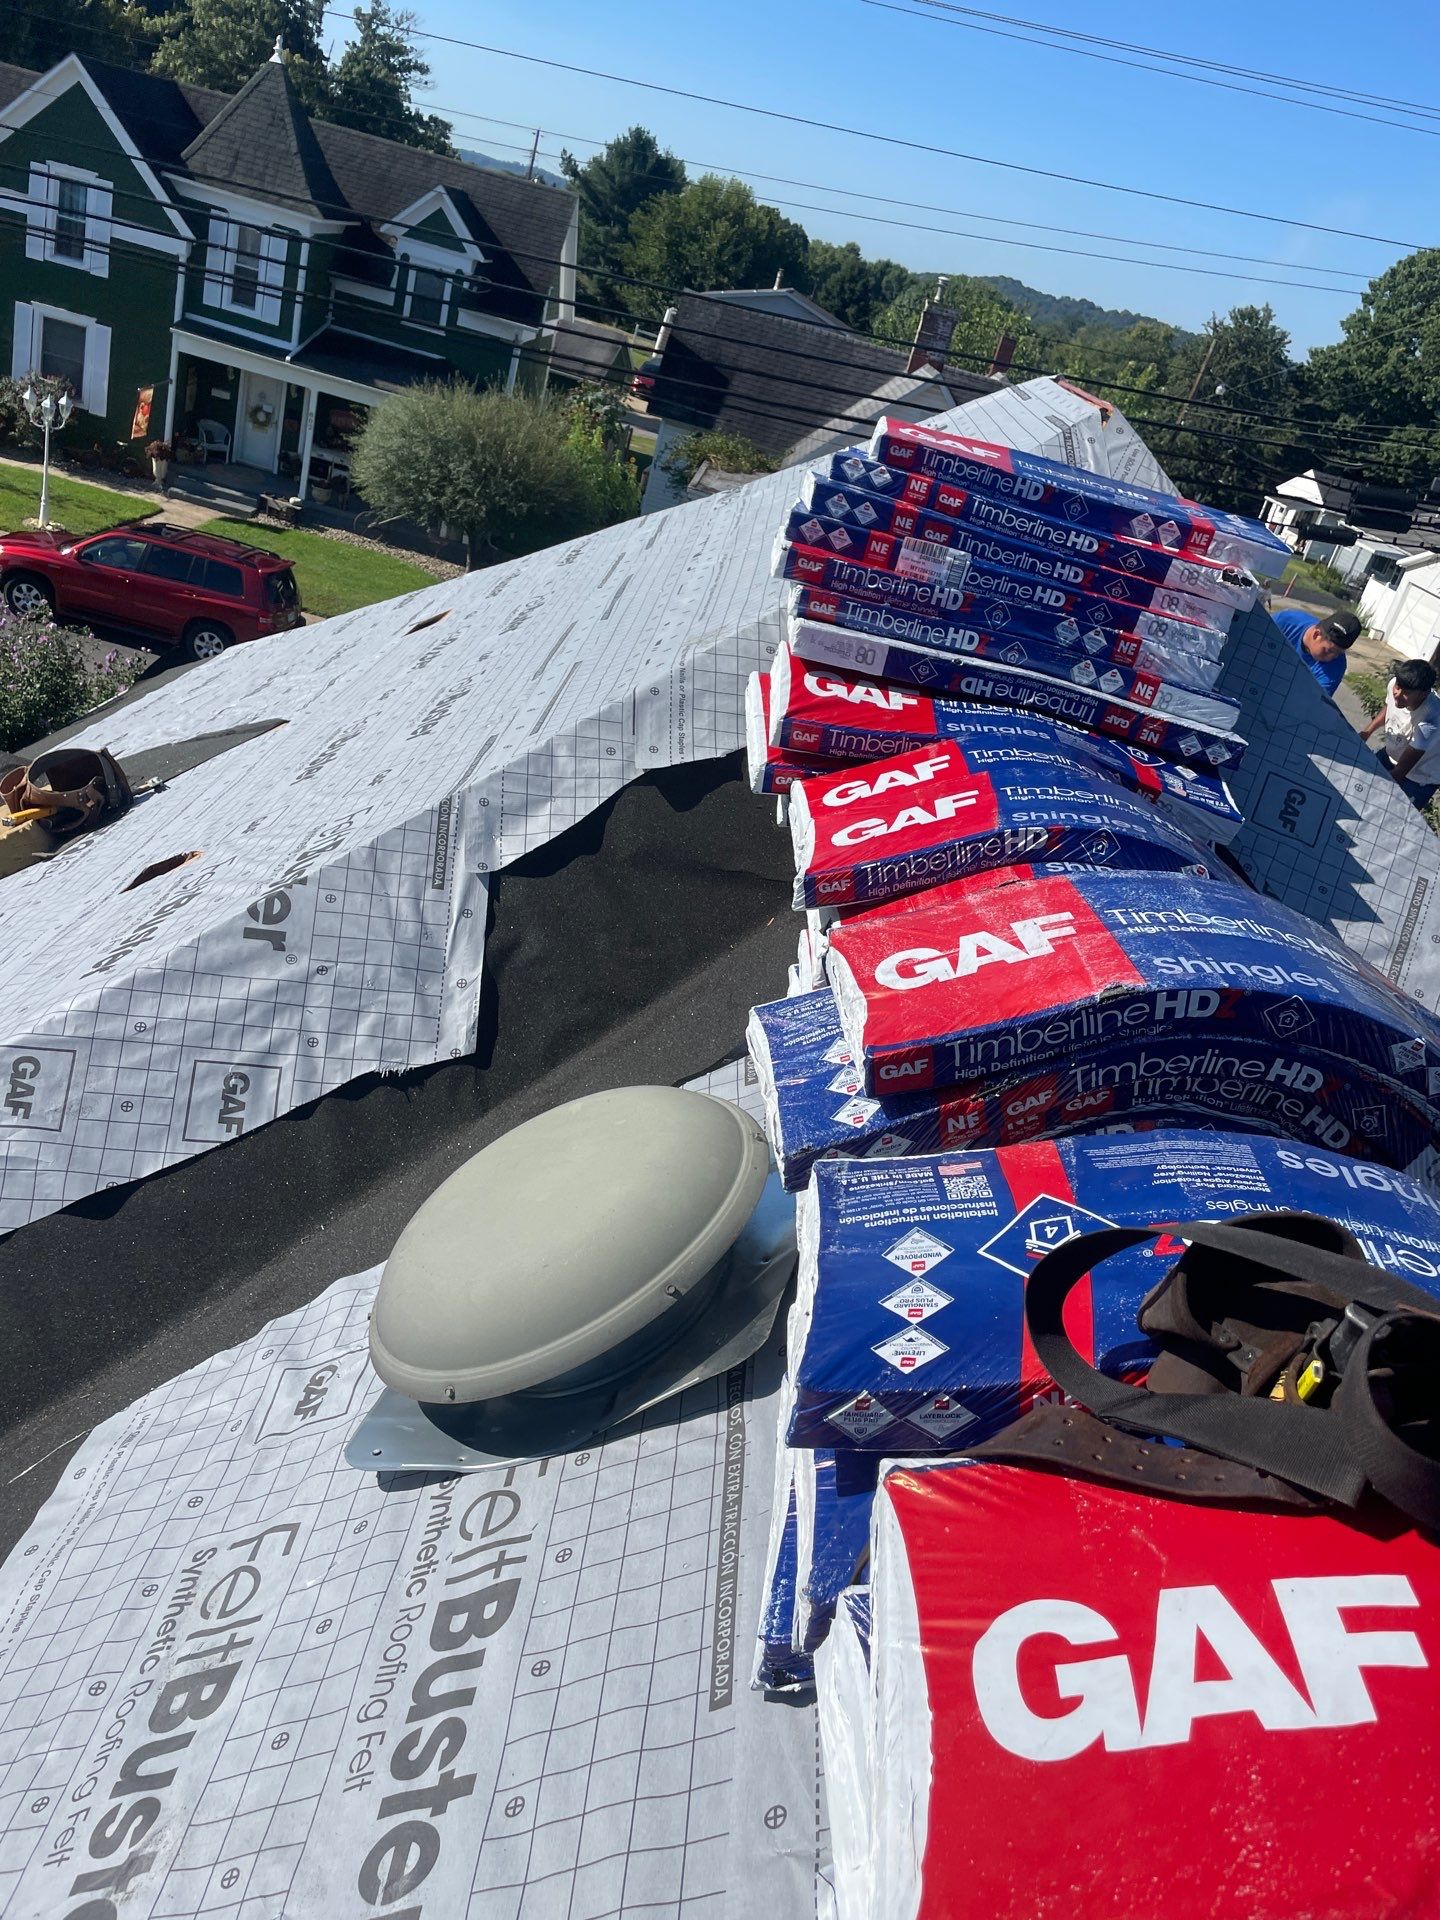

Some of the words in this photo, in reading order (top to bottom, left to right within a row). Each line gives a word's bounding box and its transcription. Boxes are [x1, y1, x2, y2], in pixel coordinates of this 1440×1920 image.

[889, 445, 914, 459] GAF
[899, 427, 1001, 459] GAF
[923, 447, 1013, 492] Timberline
[910, 479, 928, 493] NE
[939, 494, 962, 507] GAF
[895, 516, 913, 529] NE
[970, 516, 985, 525] High
[972, 497, 1066, 543] Timberline
[870, 541, 890, 554] NE
[924, 530, 949, 543] GAF
[1191, 532, 1210, 545] NE
[798, 557, 824, 572] GAF
[958, 531, 1052, 575] Timberline
[831, 580, 848, 591] High
[833, 558, 931, 603] Timberline
[965, 567, 1032, 599] berline
[809, 601, 836, 615] GAF
[845, 601, 945, 644] Timberline
[1117, 640, 1137, 655] NE
[803, 670, 921, 711] GAF
[1135, 682, 1154, 699] NE
[994, 683, 1095, 726] Timberline
[946, 723, 1051, 740] Shingles
[1105, 714, 1130, 729] GAF
[793, 731, 819, 743] GAF
[1140, 729, 1160, 744] NE
[829, 749, 847, 757] High
[822, 754, 951, 807] GAF
[1000, 786, 1152, 817] Timberline
[1009, 794, 1035, 803] High
[1276, 788, 1307, 834] GAF
[831, 790, 979, 847] GAF
[1011, 811, 1148, 833] Shingles
[433, 820, 448, 886] INCORPORADA
[861, 836, 1001, 886] Timberline
[819, 879, 850, 894] GAF
[868, 886, 890, 898] High
[1104, 908, 1310, 947] Timberline
[1128, 925, 1167, 935] High
[875, 911, 1077, 991] GAF
[1153, 957, 1340, 994] Shingles
[945, 1002, 1150, 1067] Timberline
[879, 1058, 930, 1080] GAF
[955, 1066, 987, 1080] High
[1070, 1048, 1265, 1094] Timberline
[4, 1055, 41, 1119] GAF
[218, 1071, 250, 1136] GAF
[1006, 1090, 1053, 1116] GAF
[1066, 1090, 1110, 1112] GAF
[906, 1171, 933, 1179] MADE
[839, 1210, 900, 1225] instalación
[903, 1207, 917, 1215] de
[920, 1201, 996, 1212] Instrucciones
[933, 1209, 998, 1220] Installation
[864, 1214, 930, 1228] instructions
[292, 1362, 338, 1419] GAF
[919, 1412, 961, 1420] LAYERLOCK
[728, 1433, 743, 1461] CON
[101, 1450, 124, 1481] Plastic
[92, 1481, 107, 1502] Cap
[720, 1463, 741, 1577] EXTRA-TRACCIÓN
[404, 1471, 457, 1598] Synthetic
[33, 1569, 52, 1593] Cap
[12, 1593, 42, 1634] Staples
[138, 1548, 204, 1678] Synthetic
[713, 1579, 733, 1702] INCORPORADA
[356, 1602, 427, 1724] Roofing
[972, 1574, 1428, 1763] GAF
[70, 1680, 155, 1804] Roofing
[342, 1726, 387, 1793] Felt
[42, 1808, 92, 1869] Felt
